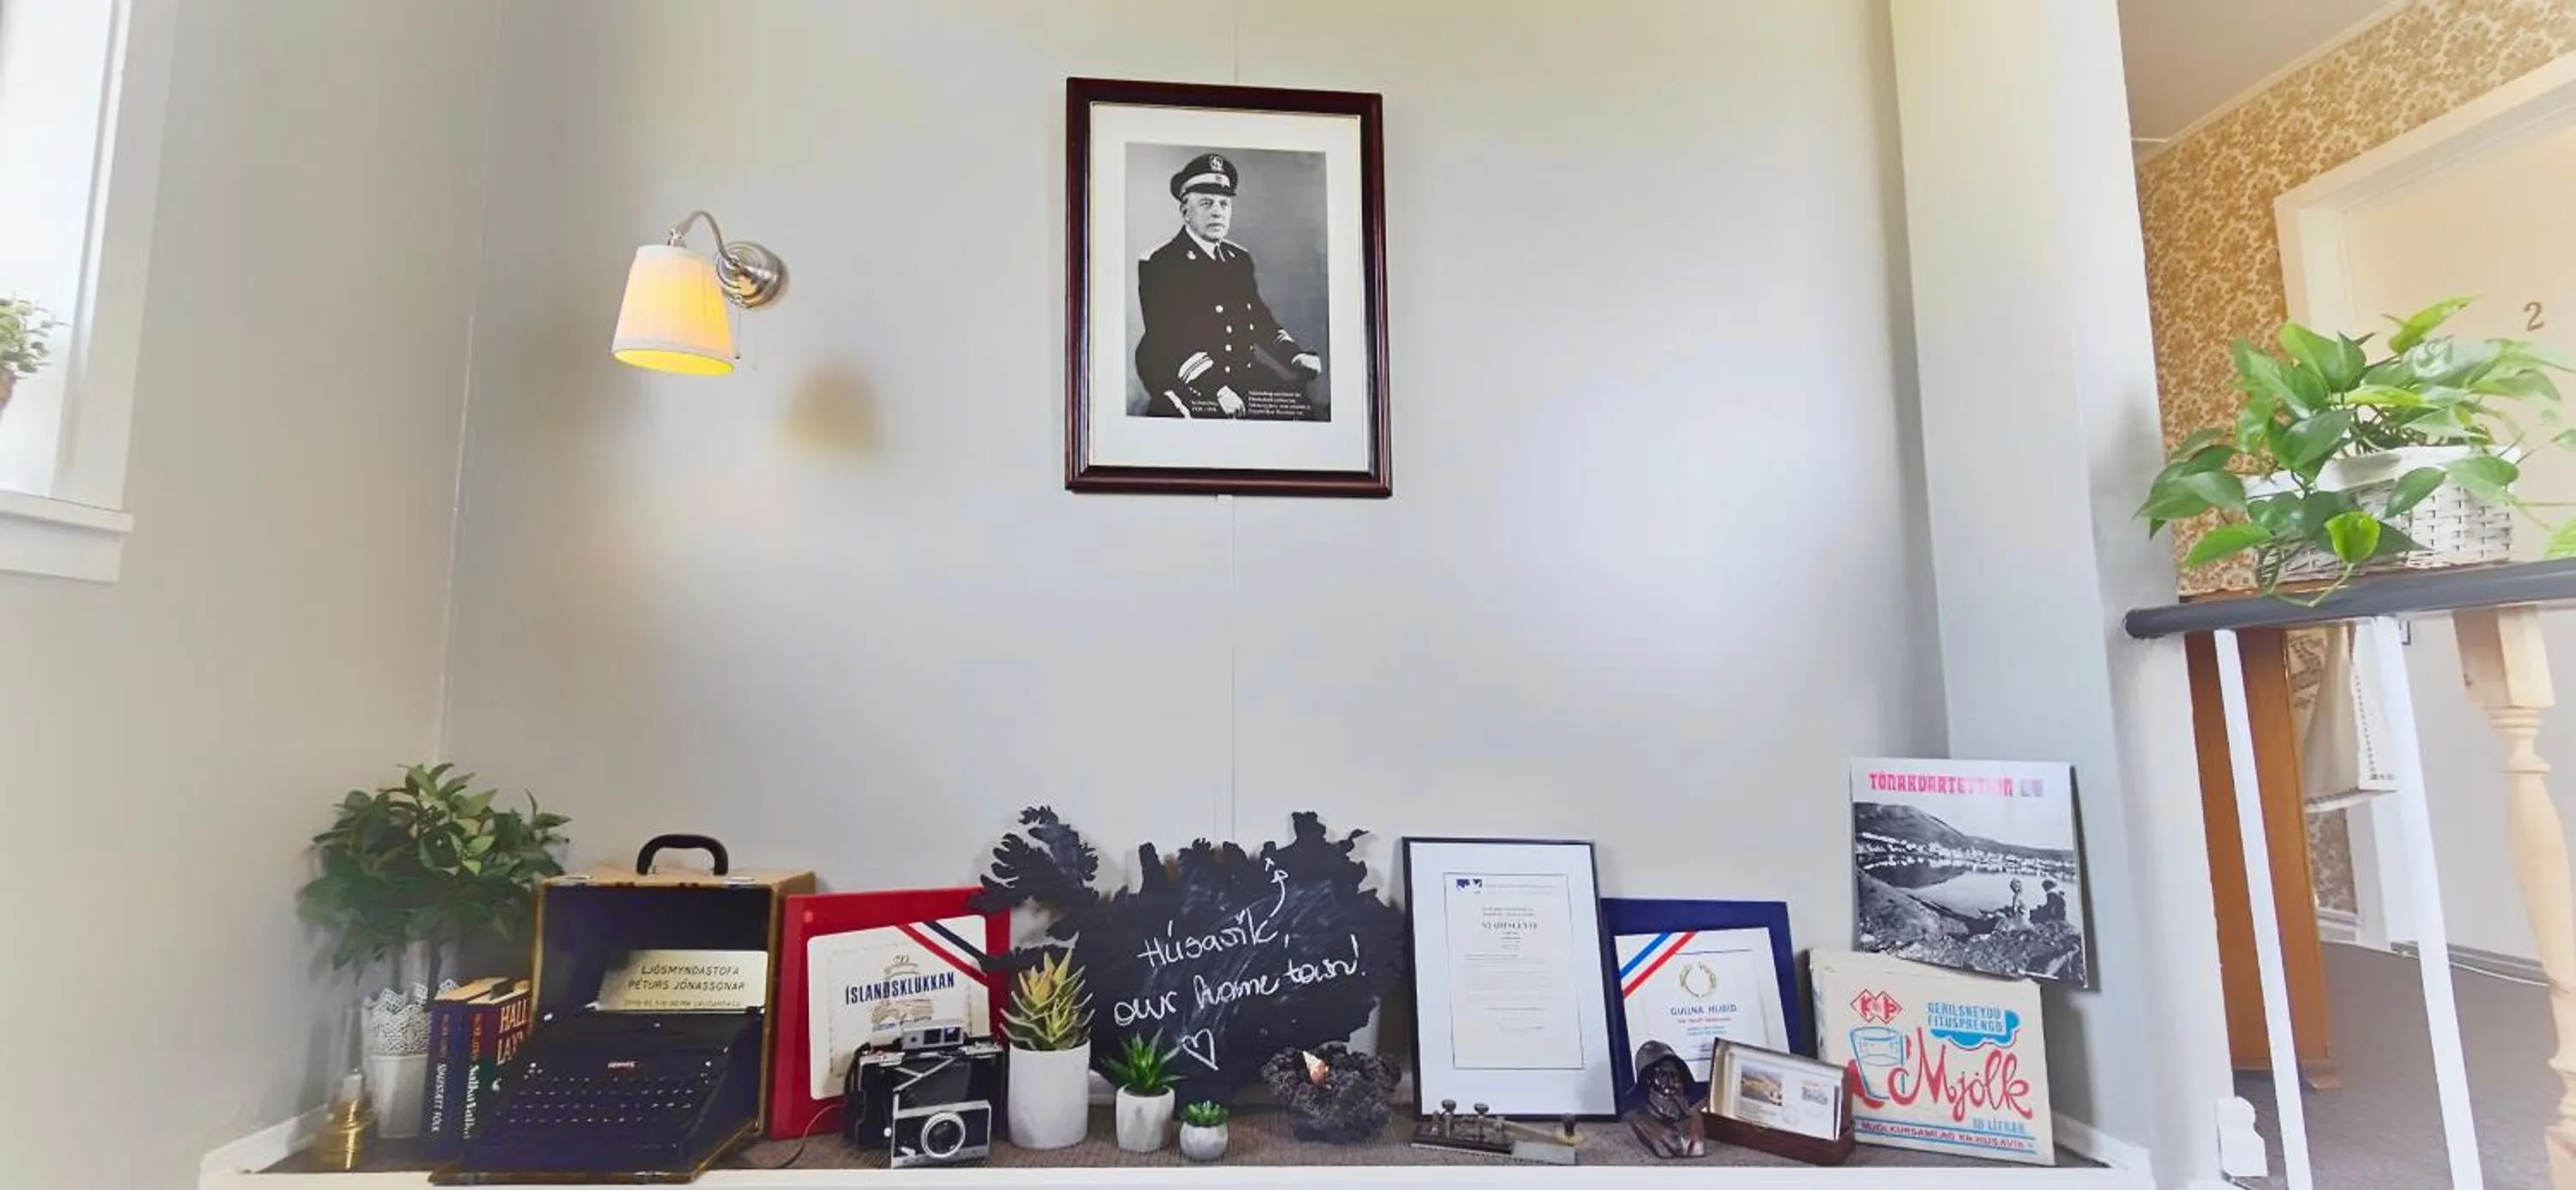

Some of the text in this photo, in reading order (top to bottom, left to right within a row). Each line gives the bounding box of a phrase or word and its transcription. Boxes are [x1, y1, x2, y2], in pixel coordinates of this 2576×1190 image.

[2523, 301, 2544, 331] 2
[1114, 933, 1367, 1028] our home town!
